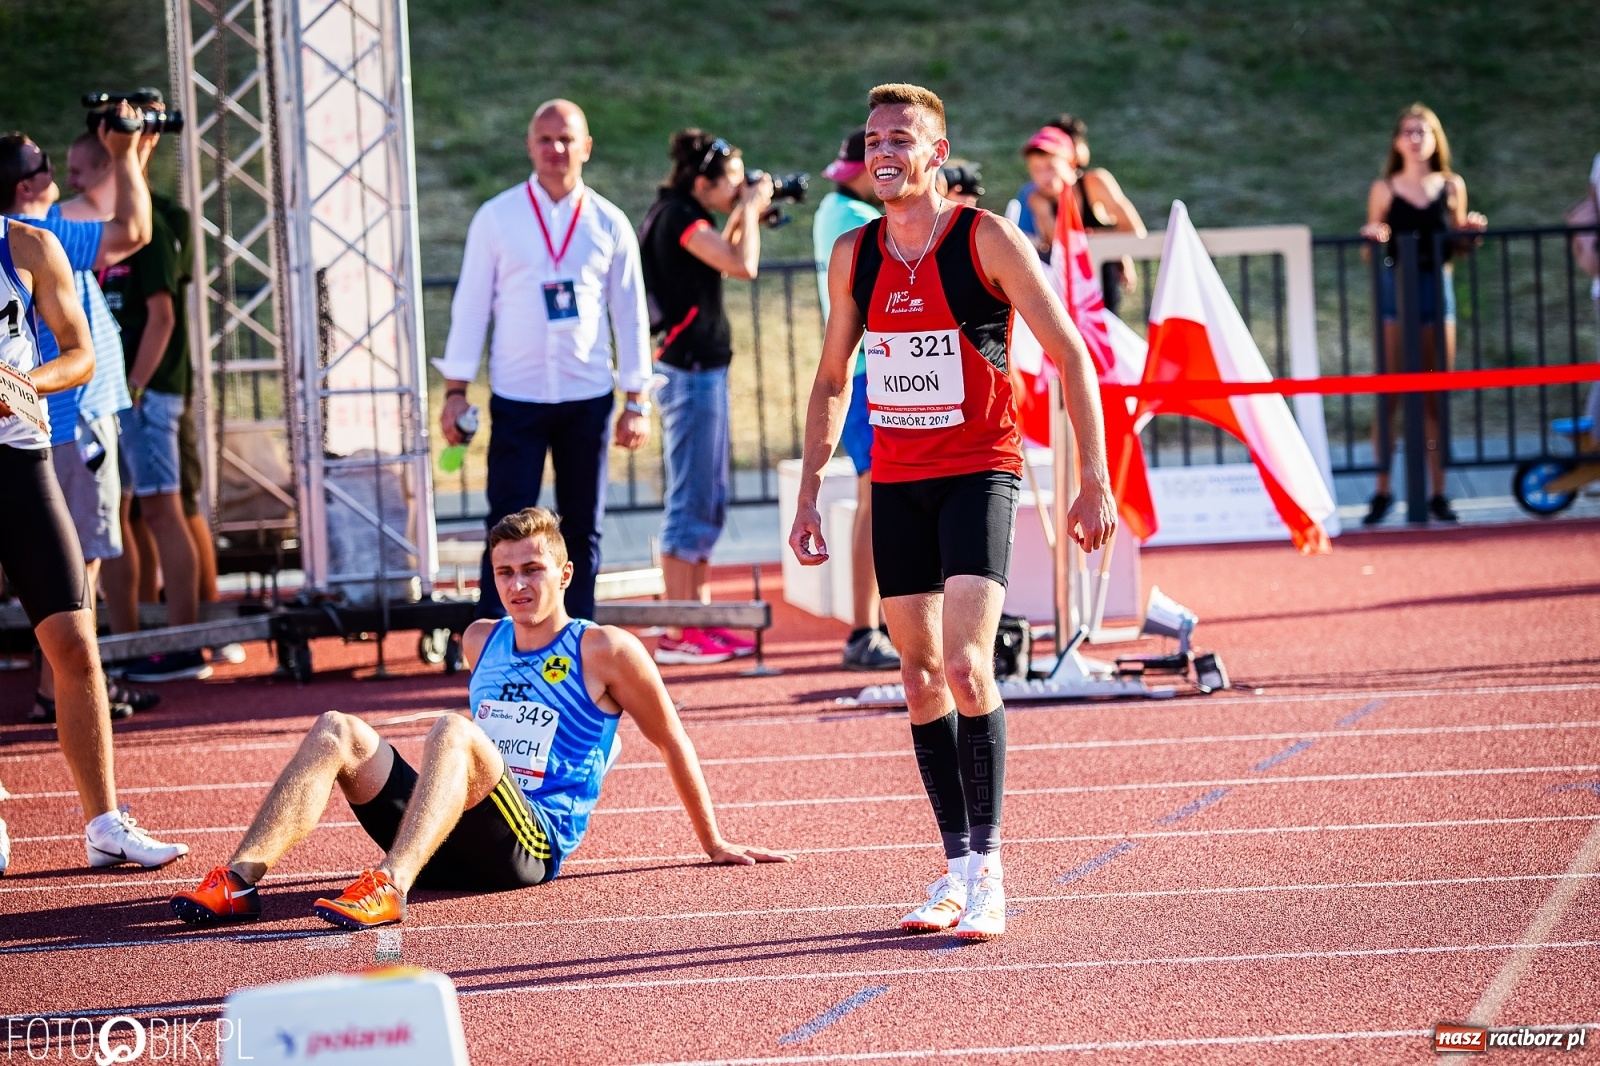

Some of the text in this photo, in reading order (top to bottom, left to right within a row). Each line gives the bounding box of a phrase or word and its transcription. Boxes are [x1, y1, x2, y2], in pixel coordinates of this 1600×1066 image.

[909, 334, 955, 358] 321
[883, 369, 940, 393] KIDOŃ
[881, 414, 950, 426] RACIBÓRZ 2019
[516, 705, 554, 728] 349
[491, 739, 541, 757] BRYCH
